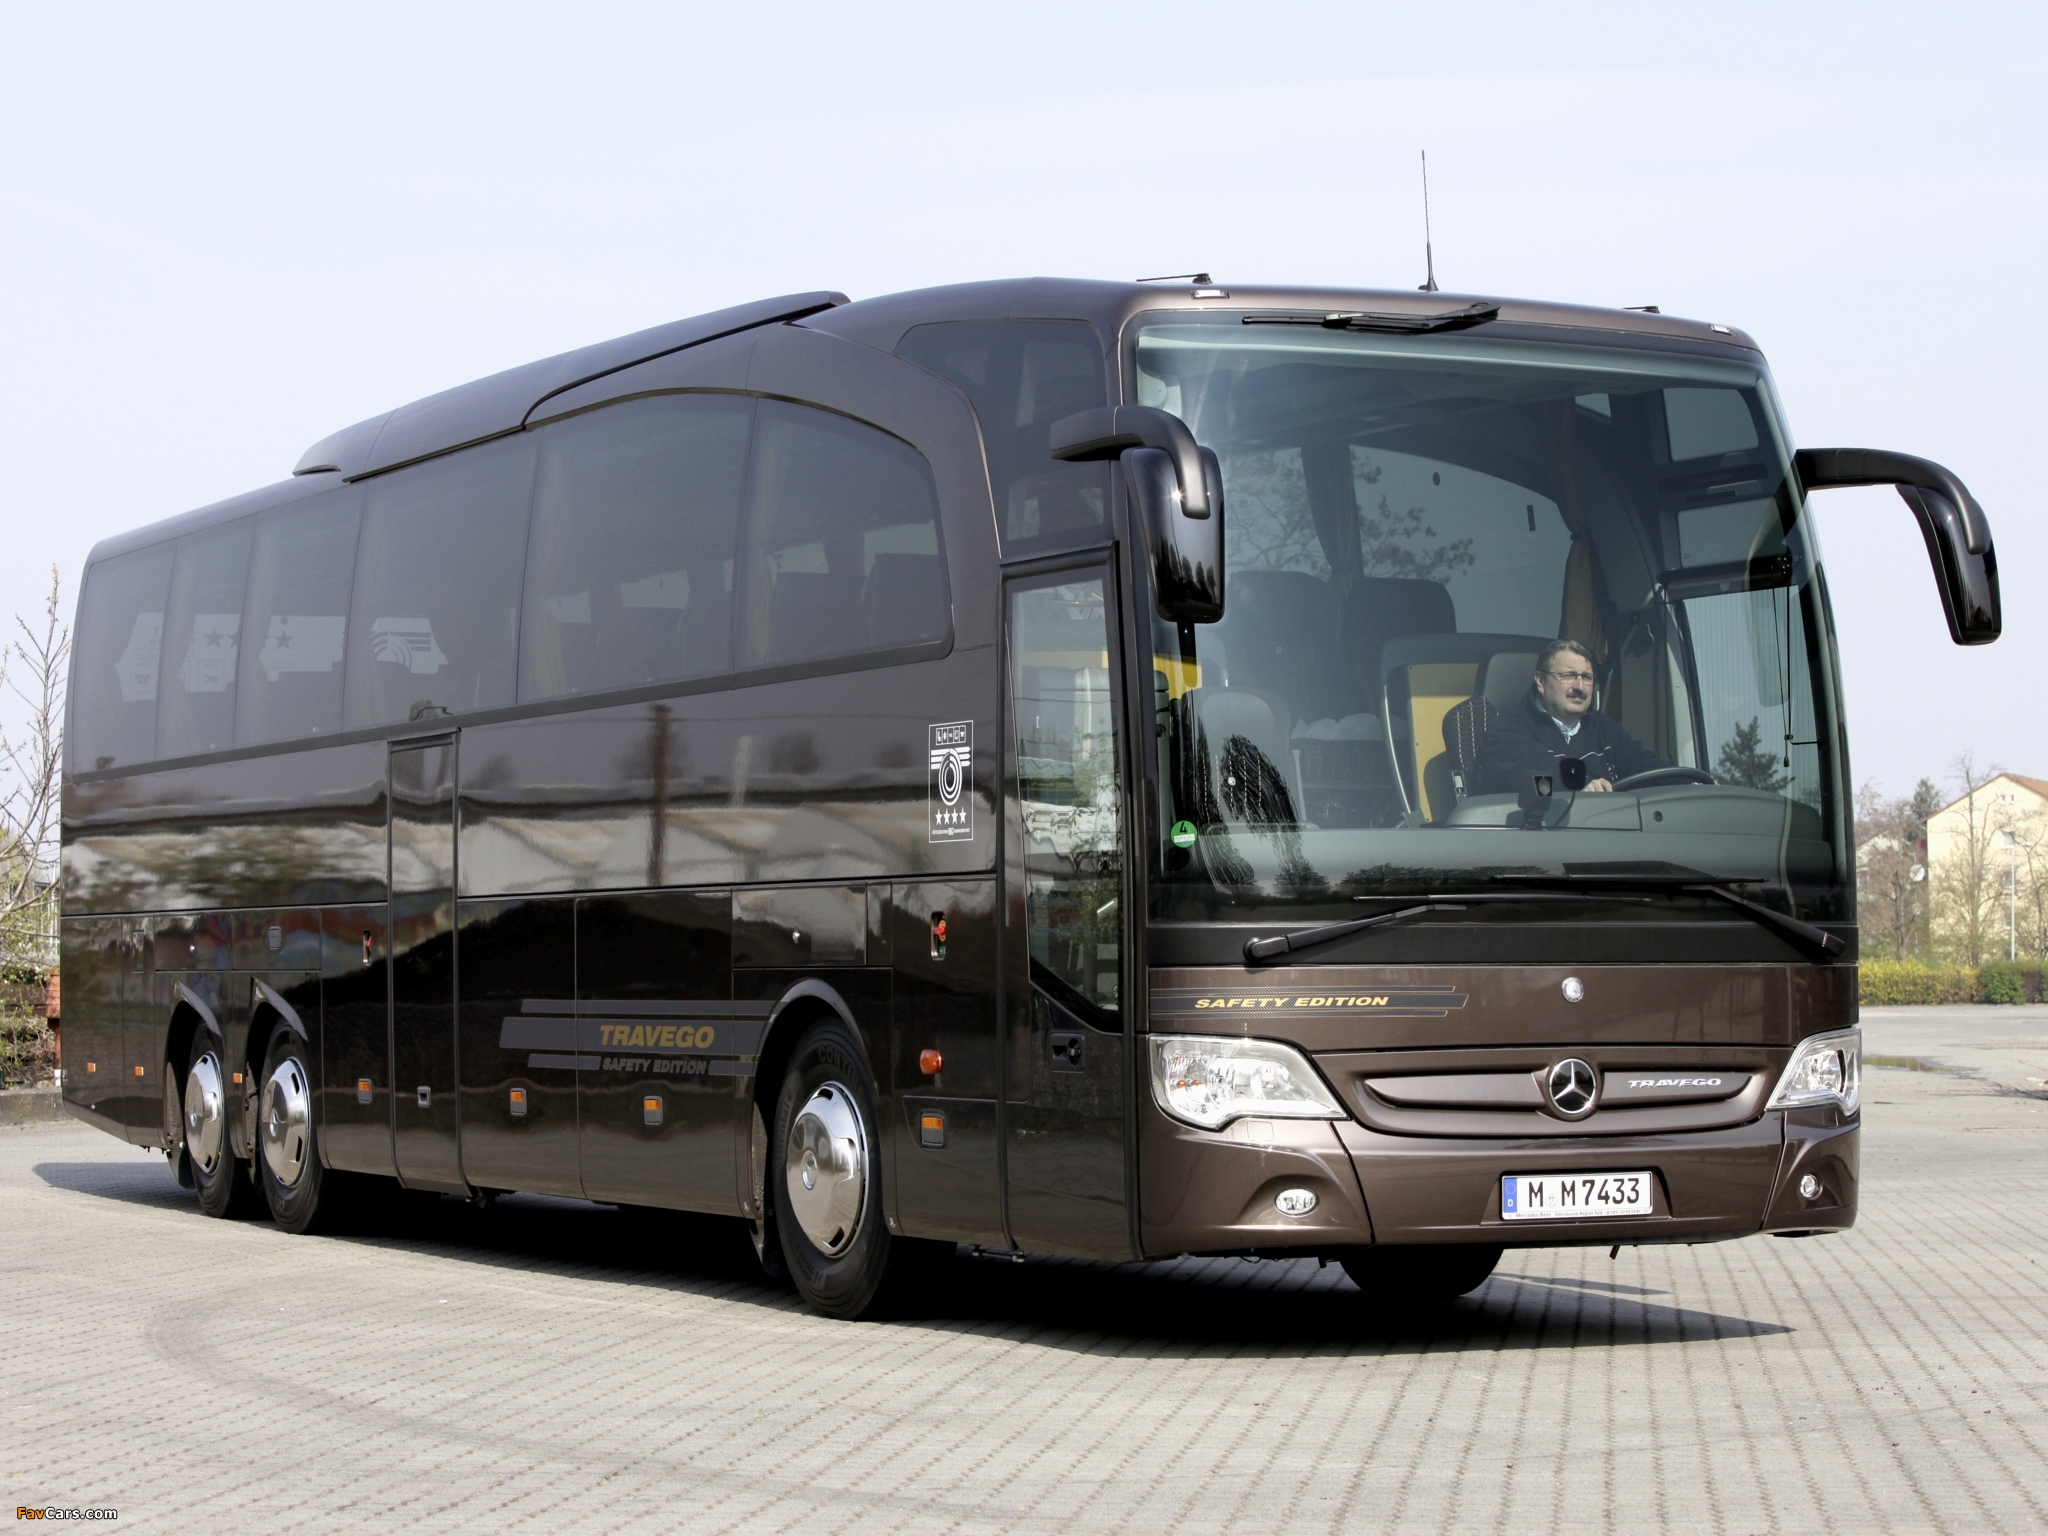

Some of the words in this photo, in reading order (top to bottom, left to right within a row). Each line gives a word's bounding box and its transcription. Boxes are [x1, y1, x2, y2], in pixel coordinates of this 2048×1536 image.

[1179, 821, 1188, 834] 4
[1194, 998, 1290, 1009] SAFETY
[1294, 996, 1390, 1007] EDITION
[600, 1024, 715, 1049] TRAVEGO
[602, 1057, 652, 1072] SAFETY
[653, 1059, 707, 1075] EDITION
[1628, 1077, 1722, 1089] TRAVEGO
[1507, 1198, 1514, 1207] D
